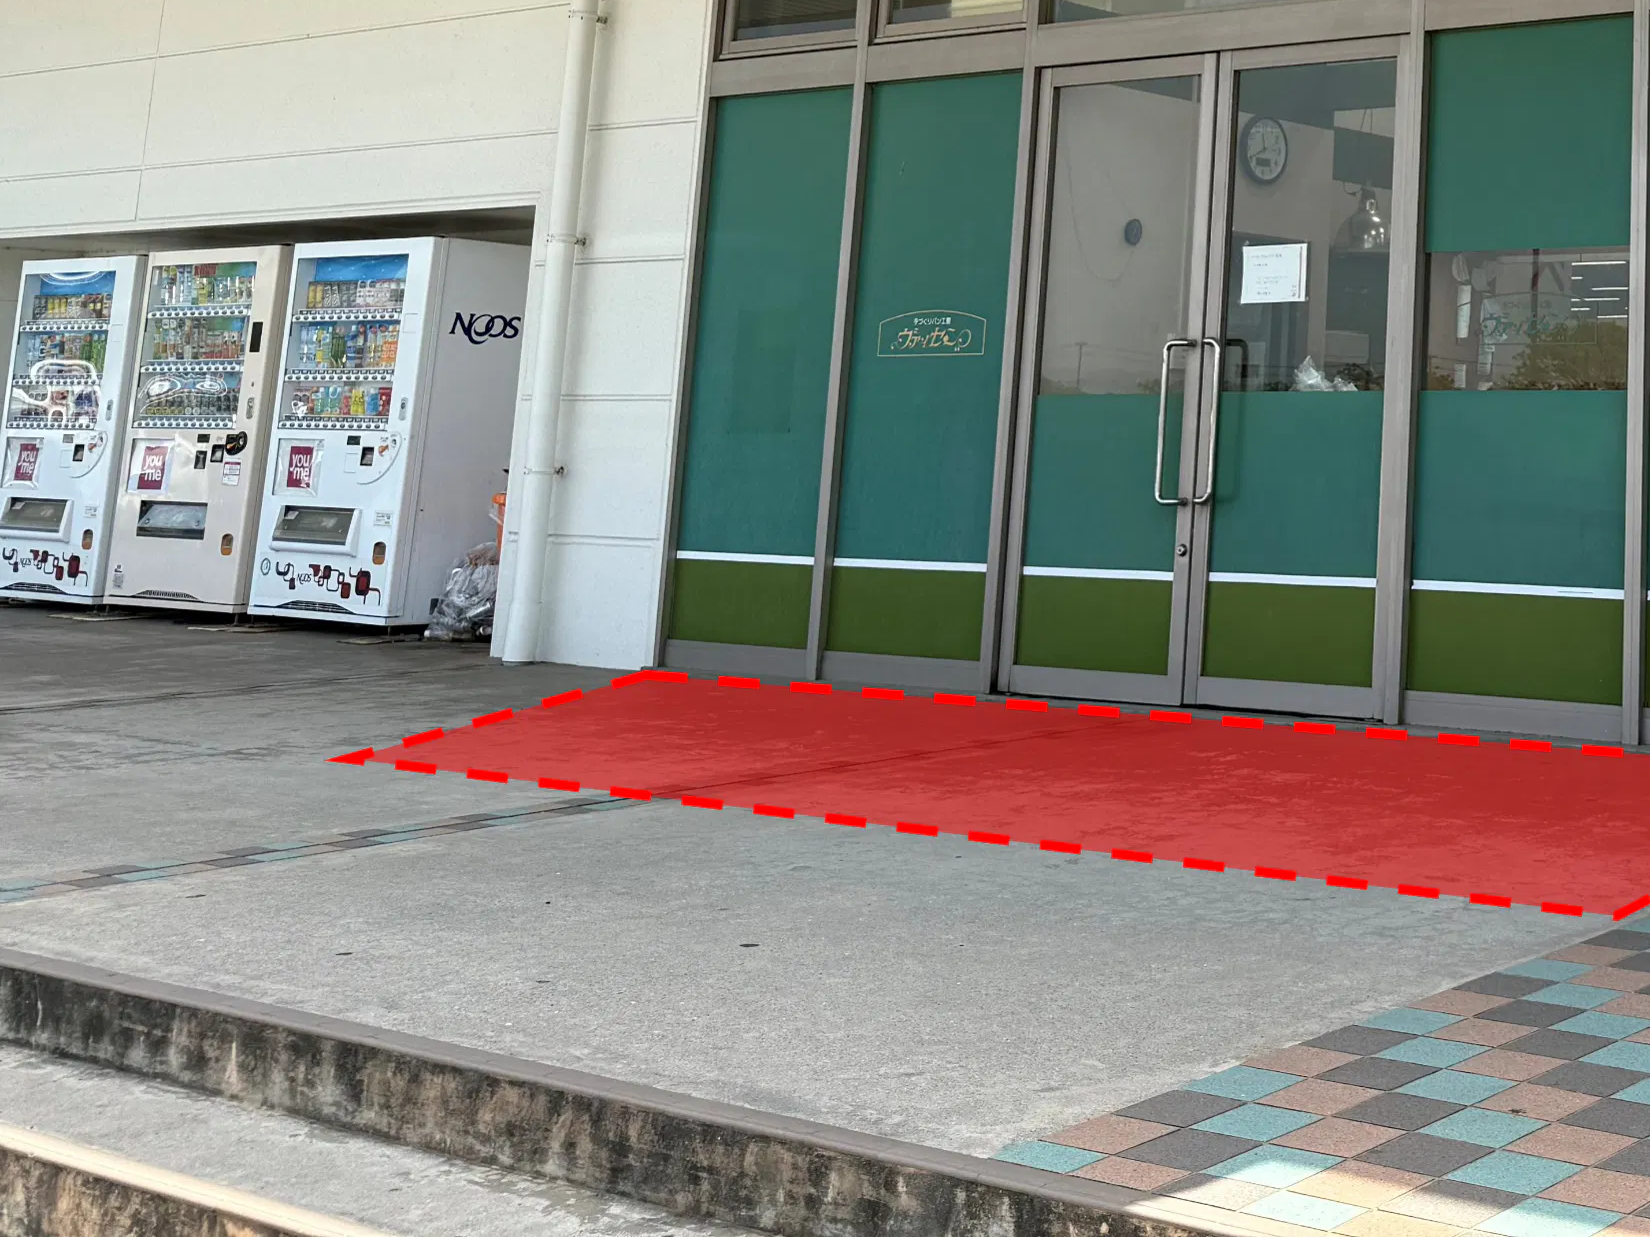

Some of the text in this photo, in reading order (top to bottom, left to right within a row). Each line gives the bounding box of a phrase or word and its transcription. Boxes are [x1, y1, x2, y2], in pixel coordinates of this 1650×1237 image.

[19, 450, 36, 465] you
[144, 454, 163, 469] you
[290, 453, 312, 471] you
[20, 463, 35, 475] me
[144, 468, 162, 481] me
[293, 468, 310, 480] me
